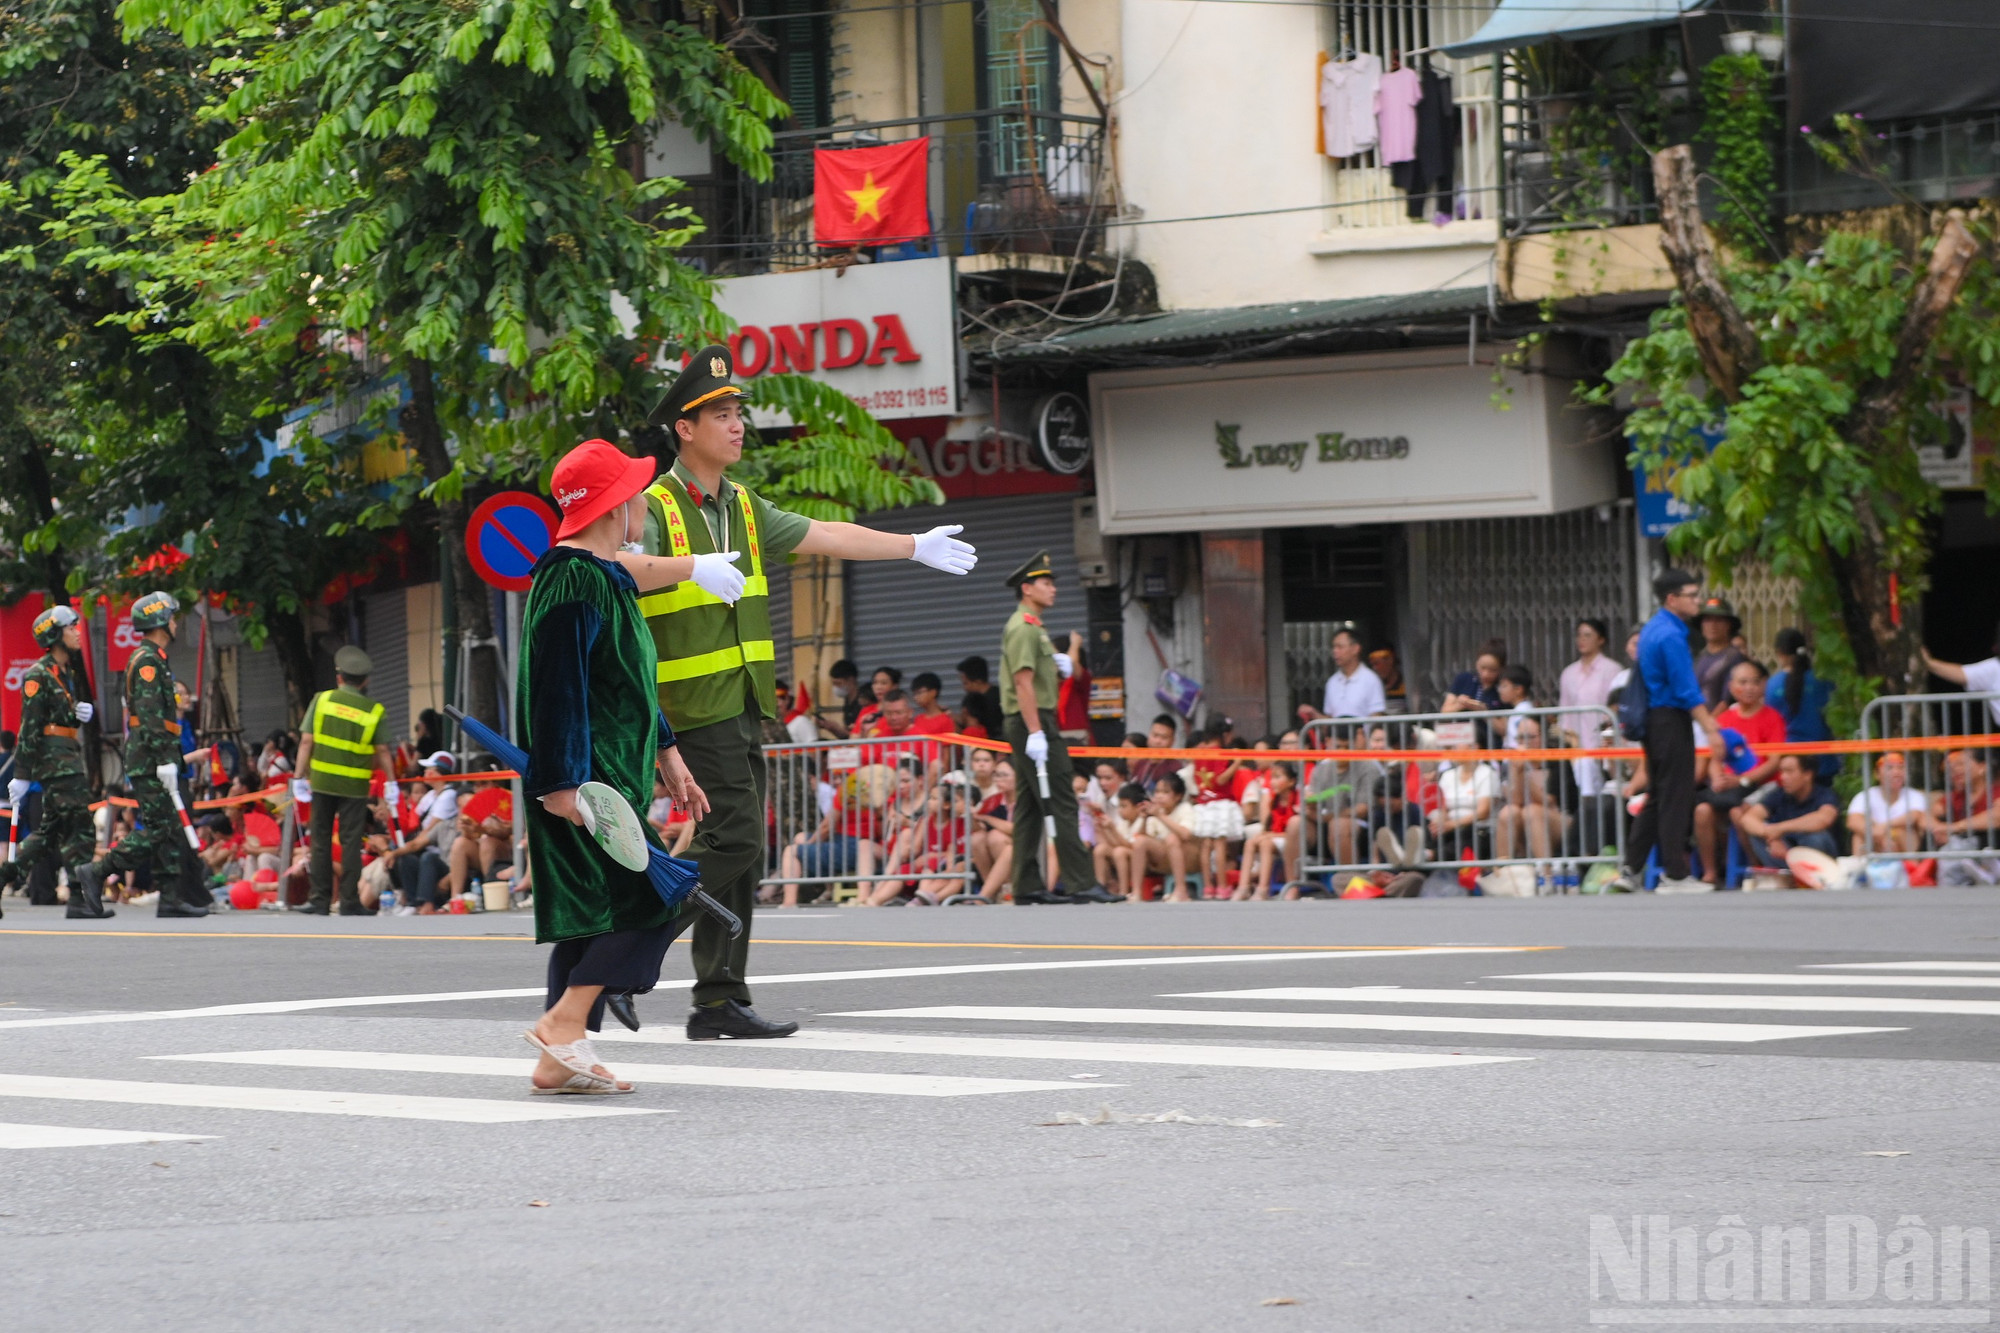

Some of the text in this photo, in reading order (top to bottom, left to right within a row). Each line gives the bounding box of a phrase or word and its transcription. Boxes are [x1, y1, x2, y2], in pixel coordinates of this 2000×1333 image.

[683, 313, 921, 378] ONDA
[906, 387, 926, 407] 118
[928, 385, 948, 406] 115
[1315, 431, 1410, 463] Home
[660, 493, 691, 558] CAH
[734, 483, 758, 558] CAHN
